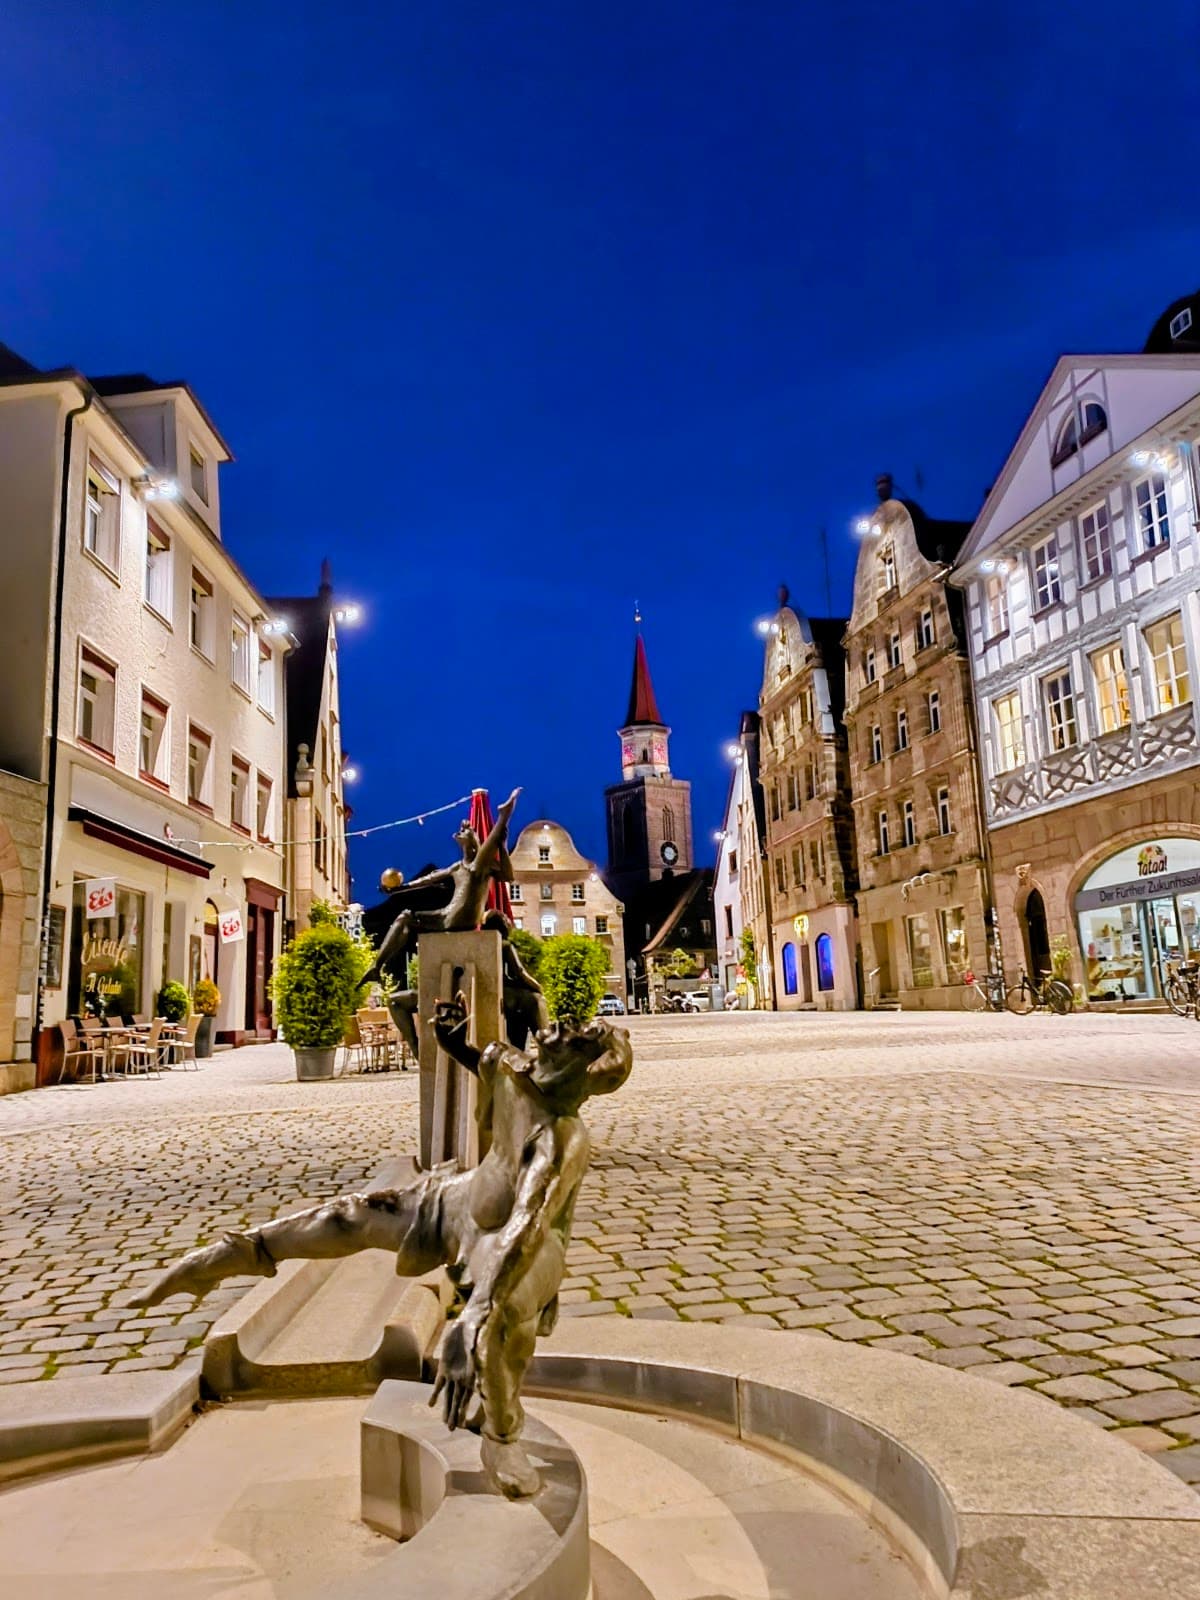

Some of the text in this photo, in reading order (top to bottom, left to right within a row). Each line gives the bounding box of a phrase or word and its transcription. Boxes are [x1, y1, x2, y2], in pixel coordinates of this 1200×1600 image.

[1137, 856, 1167, 876] Tataa!
[88, 887, 113, 912] Eis
[1099, 890, 1114, 902] Der
[1115, 884, 1146, 898] Fürther
[221, 917, 241, 937] Eis
